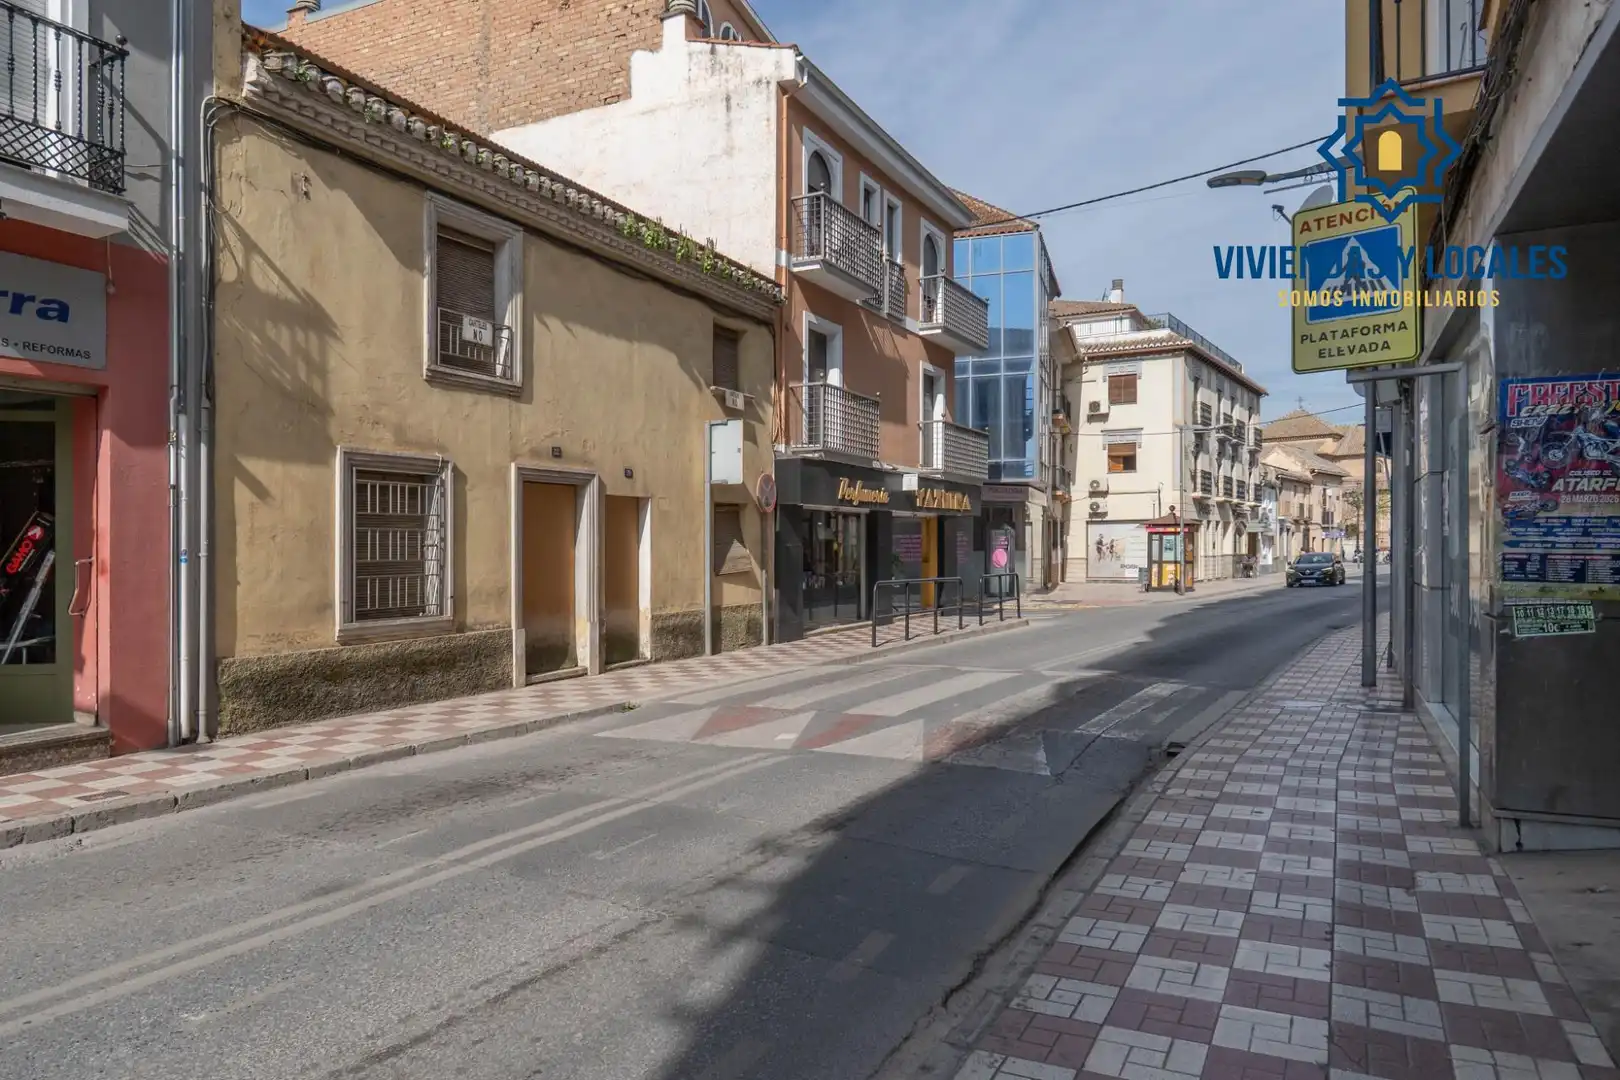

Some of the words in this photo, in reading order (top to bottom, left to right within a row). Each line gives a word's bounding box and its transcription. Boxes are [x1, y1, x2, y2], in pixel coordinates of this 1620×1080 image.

[1300, 198, 1409, 235] ATENCI
[0, 290, 70, 324] ra
[473, 328, 483, 342] NO
[1300, 320, 1409, 345] PLATAFORMA
[22, 341, 92, 360] REFORMAS
[1318, 340, 1392, 359] ELEVADA
[1572, 493, 1599, 503] MARZO
